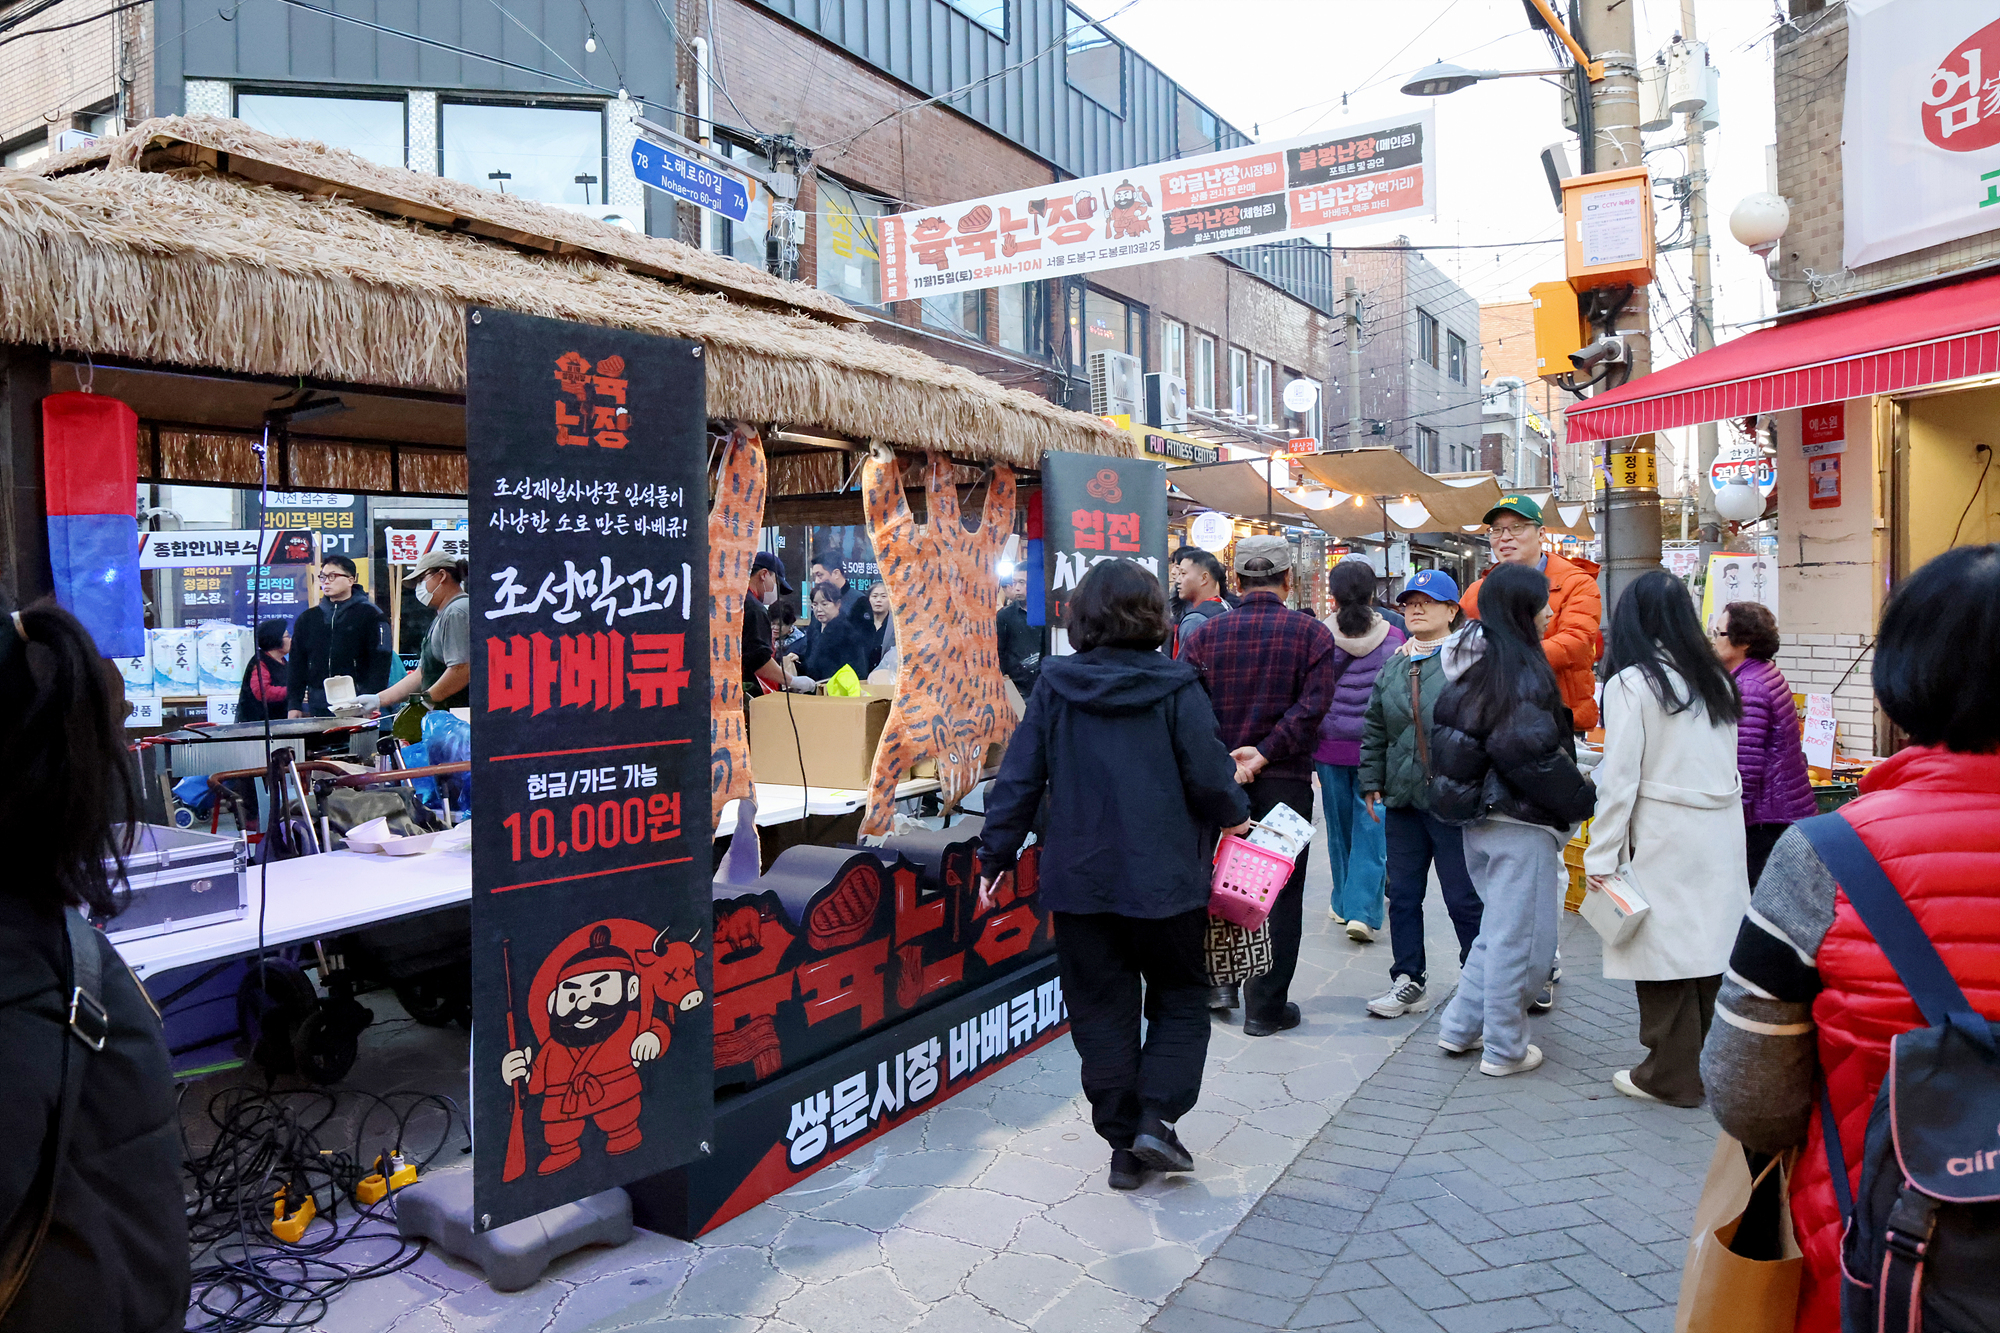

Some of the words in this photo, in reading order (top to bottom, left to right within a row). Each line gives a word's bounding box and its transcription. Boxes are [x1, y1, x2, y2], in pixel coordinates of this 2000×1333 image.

[636, 152, 648, 169] 78
[661, 154, 722, 195] 노해로60길
[733, 194, 745, 210] 74
[661, 175, 699, 200] Nohae-ro
[700, 191, 722, 210] 60-gil
[1602, 201, 1618, 209] CCTV
[1047, 255, 1066, 267] 서울
[1066, 250, 1097, 265] 도봉구
[1149, 240, 1161, 252] 25
[1149, 435, 1165, 455] FUN
[1166, 440, 1194, 460] FITNESS
[1194, 446, 1217, 463] CENTER
[494, 476, 619, 505] 조선제일사냥꾼
[624, 482, 684, 508] 임석돌이
[489, 508, 550, 534] 사냥한
[555, 513, 591, 533] 소로
[595, 512, 630, 536] 만든
[634, 514, 688, 538] 바베큐!
[1071, 508, 1141, 553] 엽전
[153, 540, 259, 558] 종합안내부스
[322, 533, 355, 553] PT
[183, 578, 221, 591] 청결한
[183, 592, 226, 606] 헬스장.
[484, 556, 692, 627] 조선막고기
[486, 629, 692, 718] 바베큐
[527, 766, 617, 801] 현금/카드
[622, 763, 658, 789] 가능
[502, 791, 682, 862] 10,000원
[785, 1035, 942, 1166] 쌍문시장
[950, 975, 1069, 1081] 바베큐파
[1946, 1149, 2000, 1177] air
